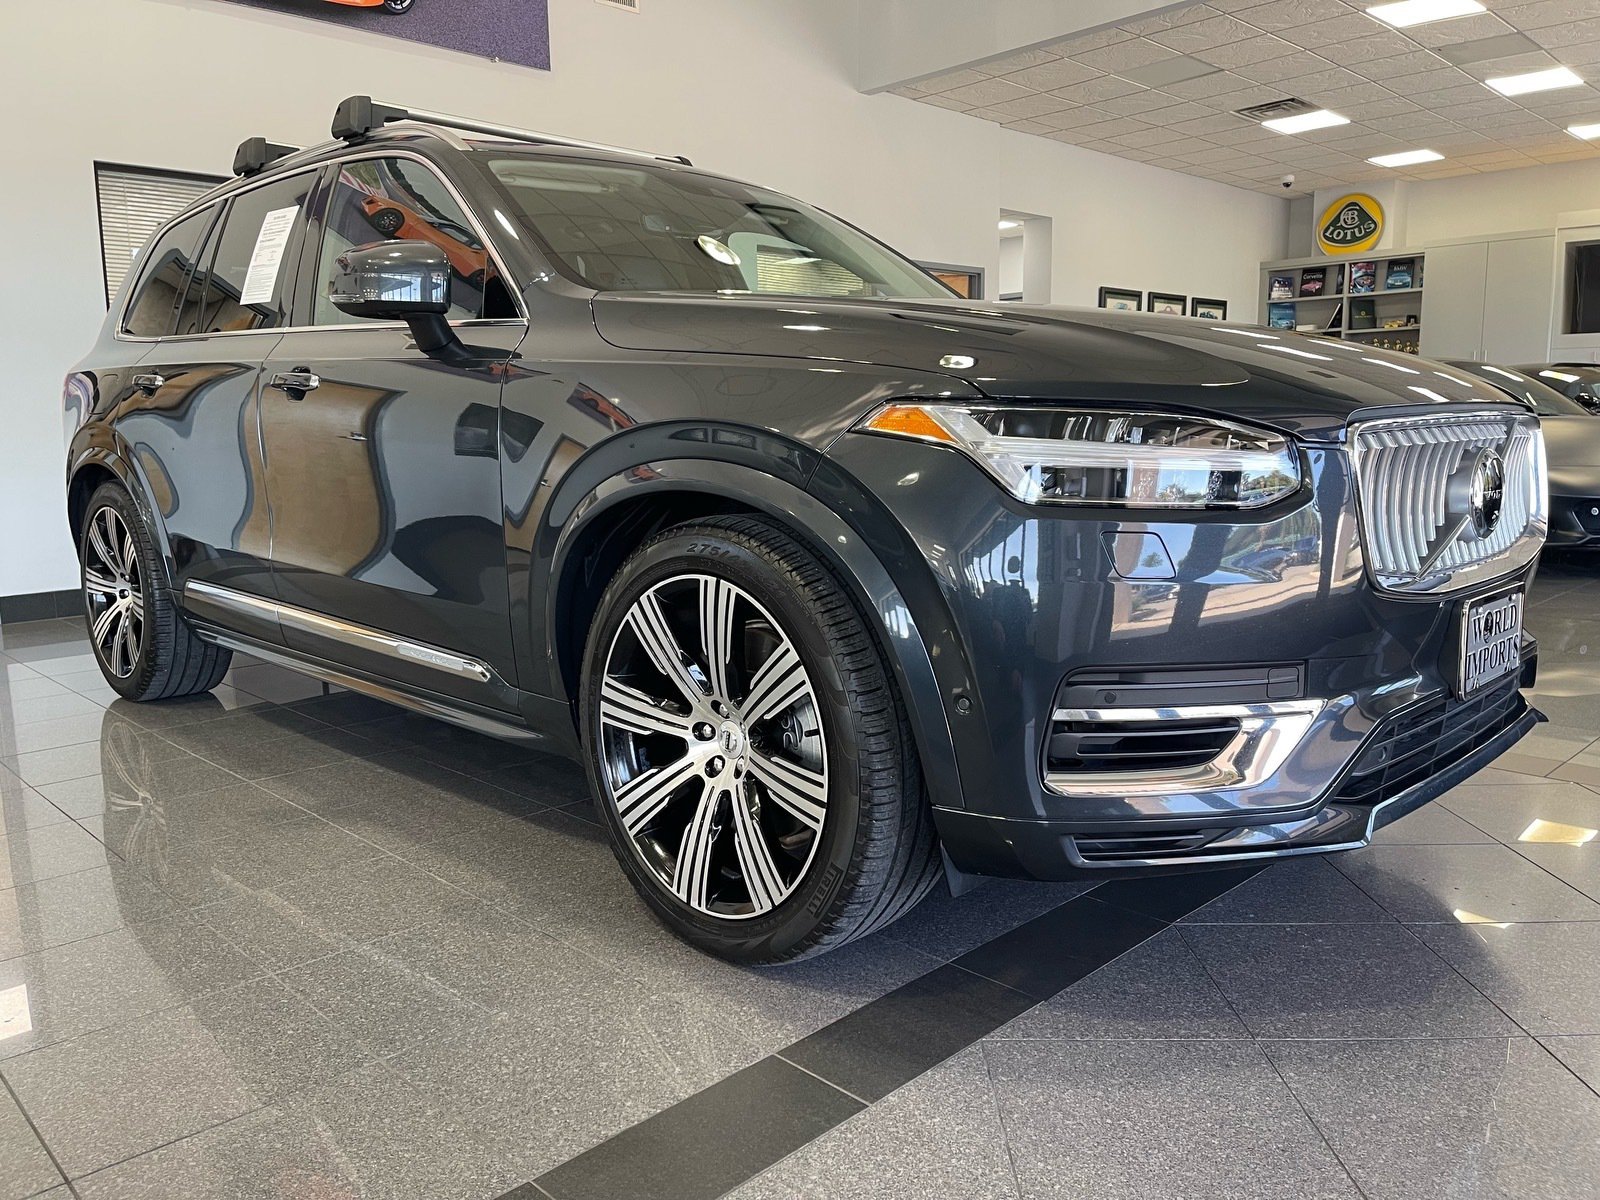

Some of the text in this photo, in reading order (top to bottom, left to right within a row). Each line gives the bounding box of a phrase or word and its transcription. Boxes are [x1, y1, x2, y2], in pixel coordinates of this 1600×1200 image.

[1324, 221, 1375, 241] LOTUS
[1472, 603, 1518, 643] WORLD
[1466, 634, 1520, 680] IMPORTS
